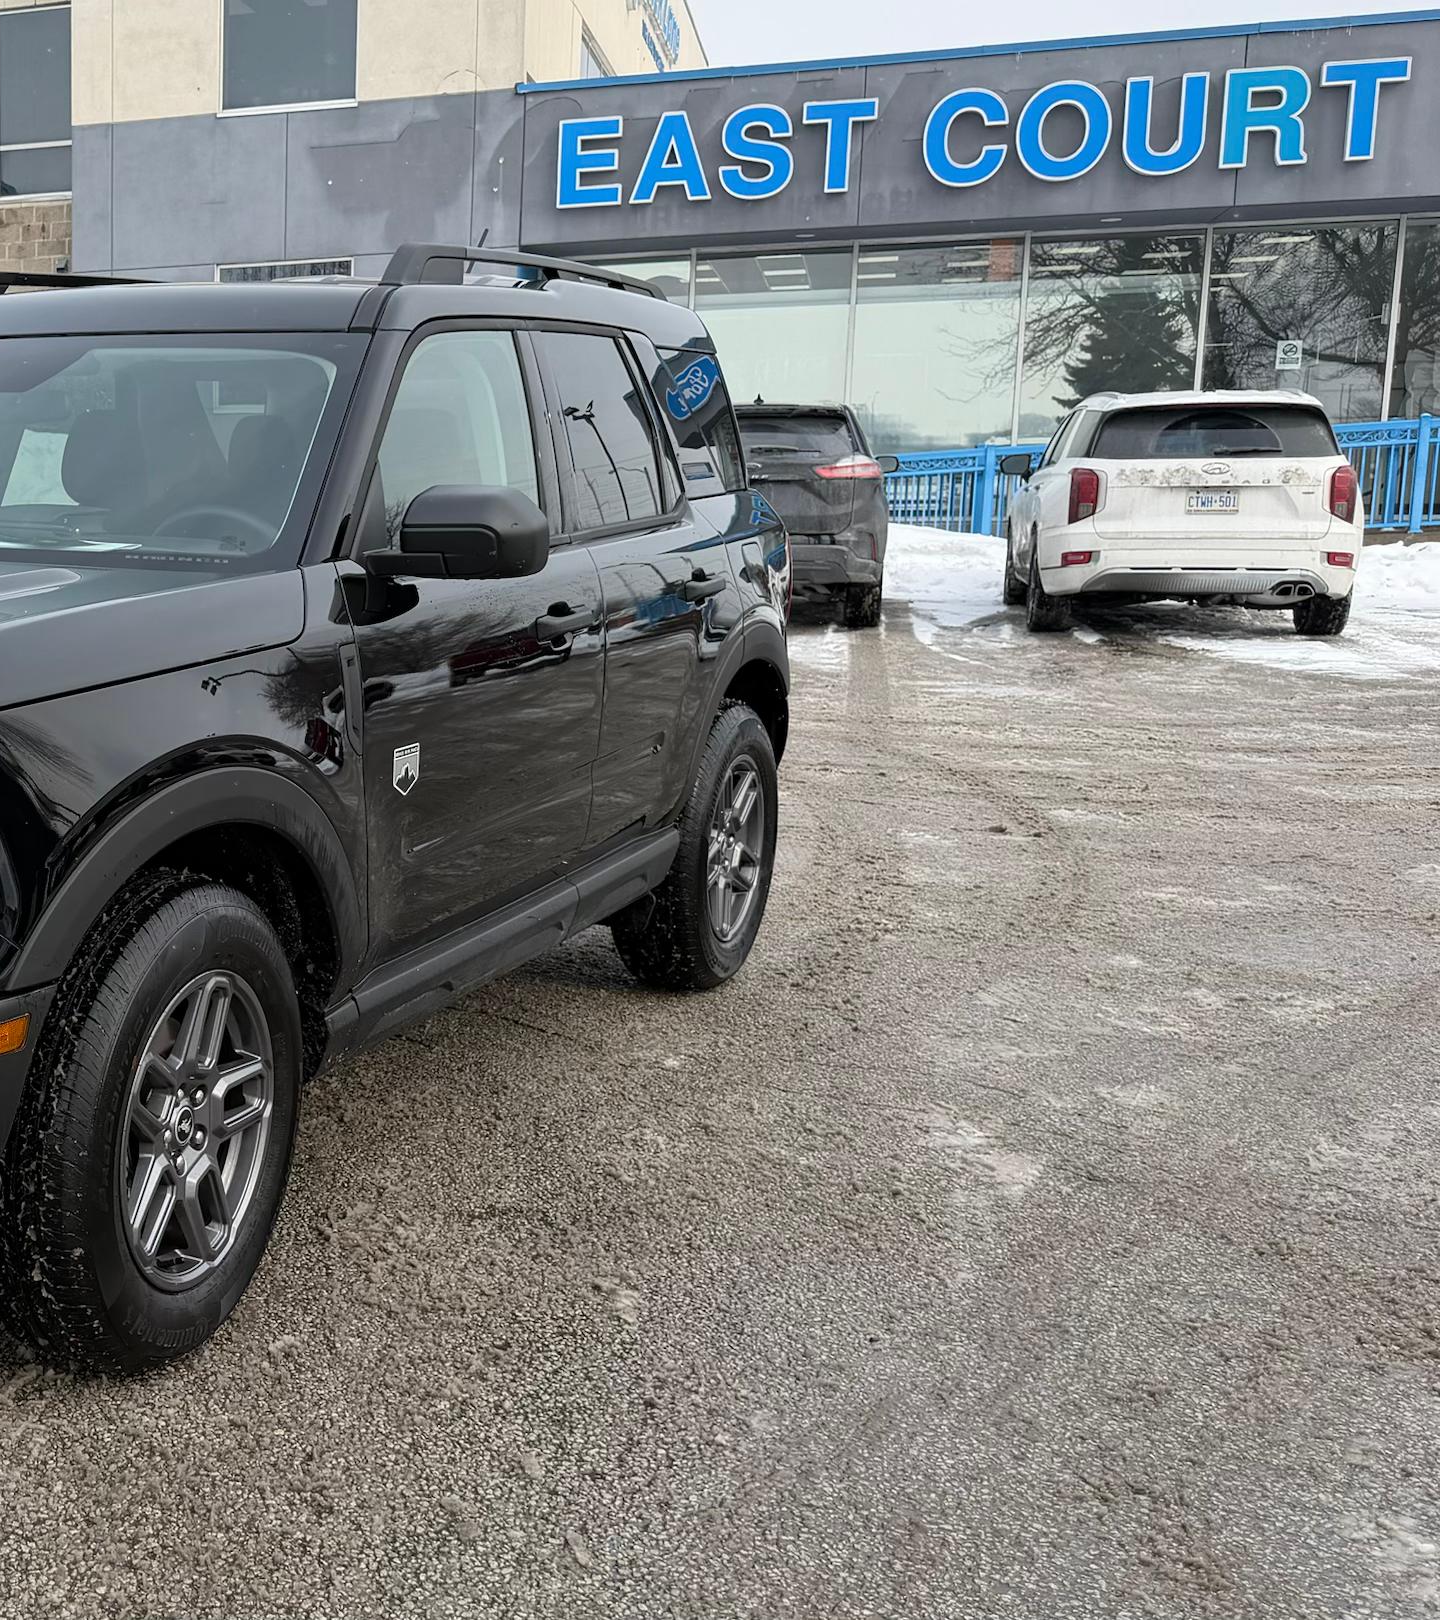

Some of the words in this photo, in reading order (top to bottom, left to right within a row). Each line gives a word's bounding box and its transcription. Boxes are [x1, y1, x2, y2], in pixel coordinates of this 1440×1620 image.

[555, 97, 879, 209] EAST
[922, 56, 1414, 188] COURT
[1188, 496, 1213, 508] CTWH
[1218, 496, 1236, 508] 501
